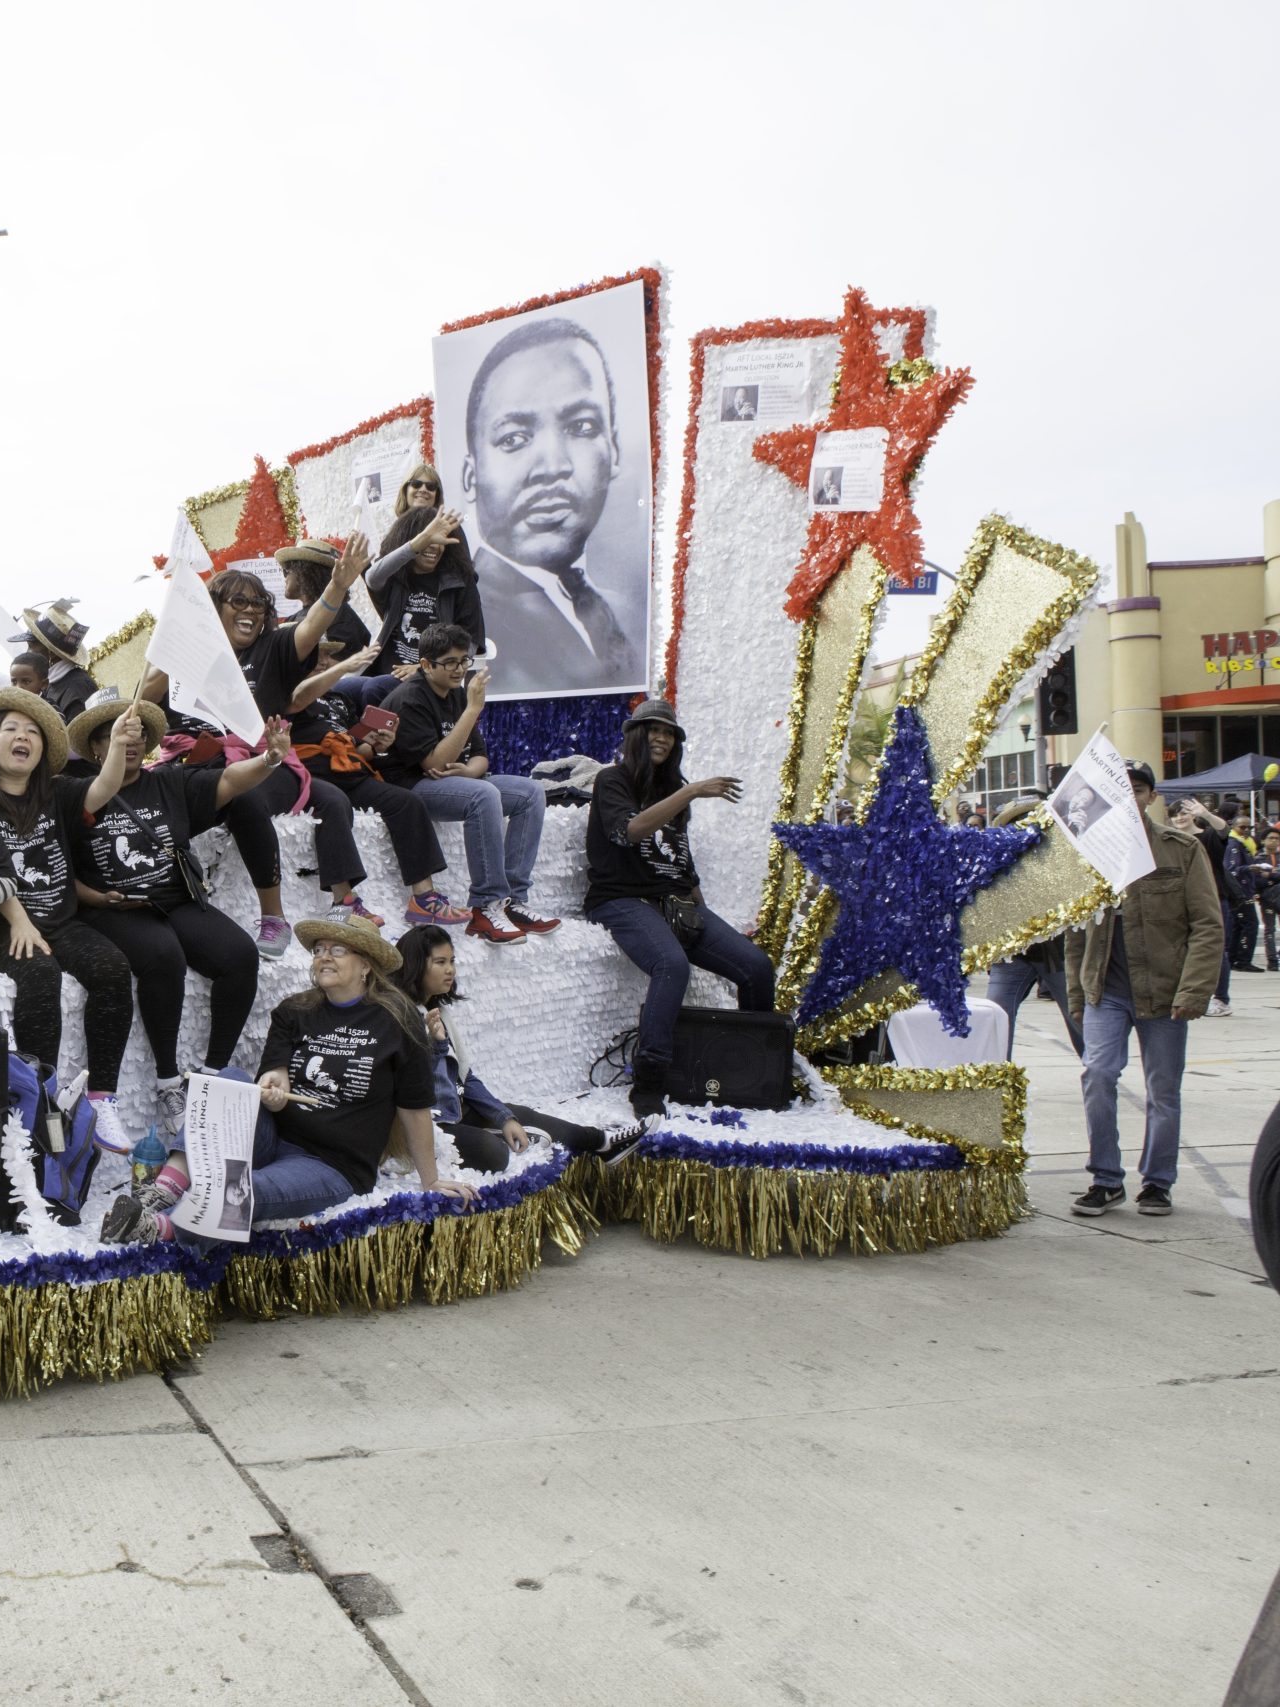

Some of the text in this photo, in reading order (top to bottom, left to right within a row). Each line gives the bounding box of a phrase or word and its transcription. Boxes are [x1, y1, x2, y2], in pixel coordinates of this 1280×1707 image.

[750, 363, 775, 371] LUTHER
[1205, 658, 1254, 673] RIBS
[1088, 748, 1116, 781] MARTIN
[308, 1044, 356, 1057] CELEBRATION
[349, 1037, 368, 1046] King
[367, 1037, 378, 1045] Jr.
[189, 1100, 198, 1134] 1521A
[199, 1100, 207, 1129] KING
[201, 1133, 213, 1179] LUTHER
[190, 1182, 212, 1226] MARTIN
